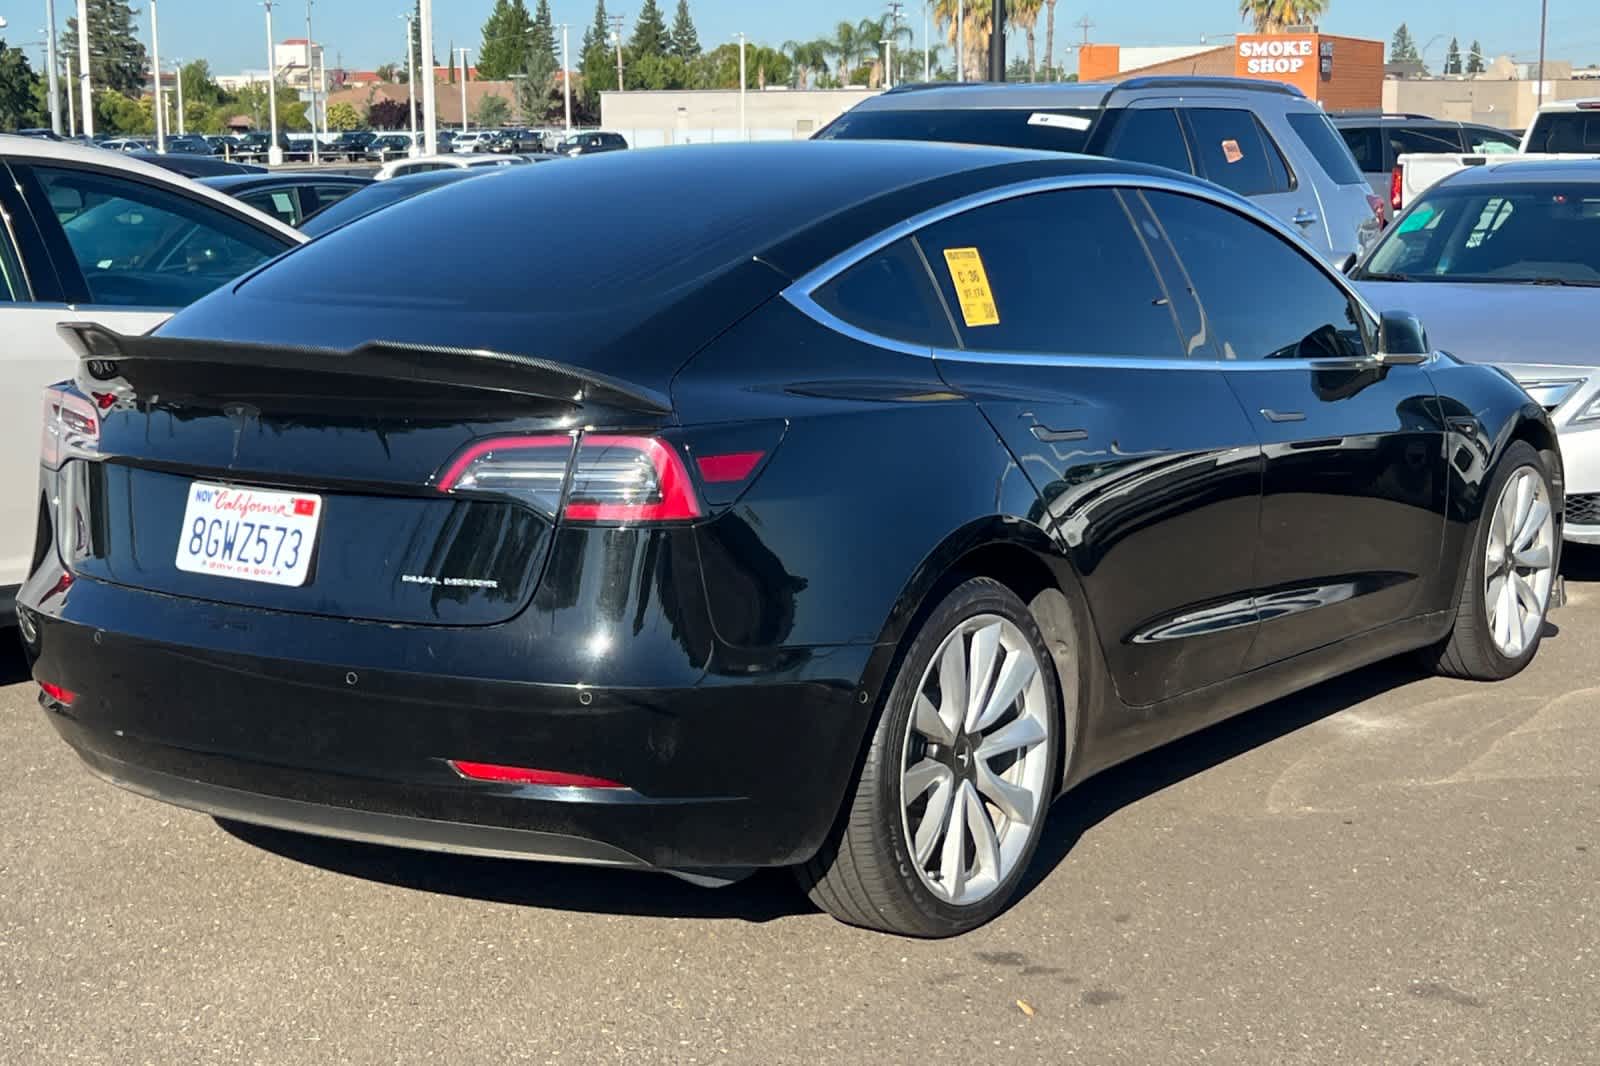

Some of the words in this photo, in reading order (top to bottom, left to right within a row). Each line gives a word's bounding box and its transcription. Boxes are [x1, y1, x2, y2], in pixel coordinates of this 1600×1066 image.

[1239, 40, 1313, 57] SMOKE
[1247, 58, 1304, 73] SHOP
[195, 489, 214, 503] NOV
[214, 490, 293, 519] California
[188, 516, 303, 569] 8GWZ573
